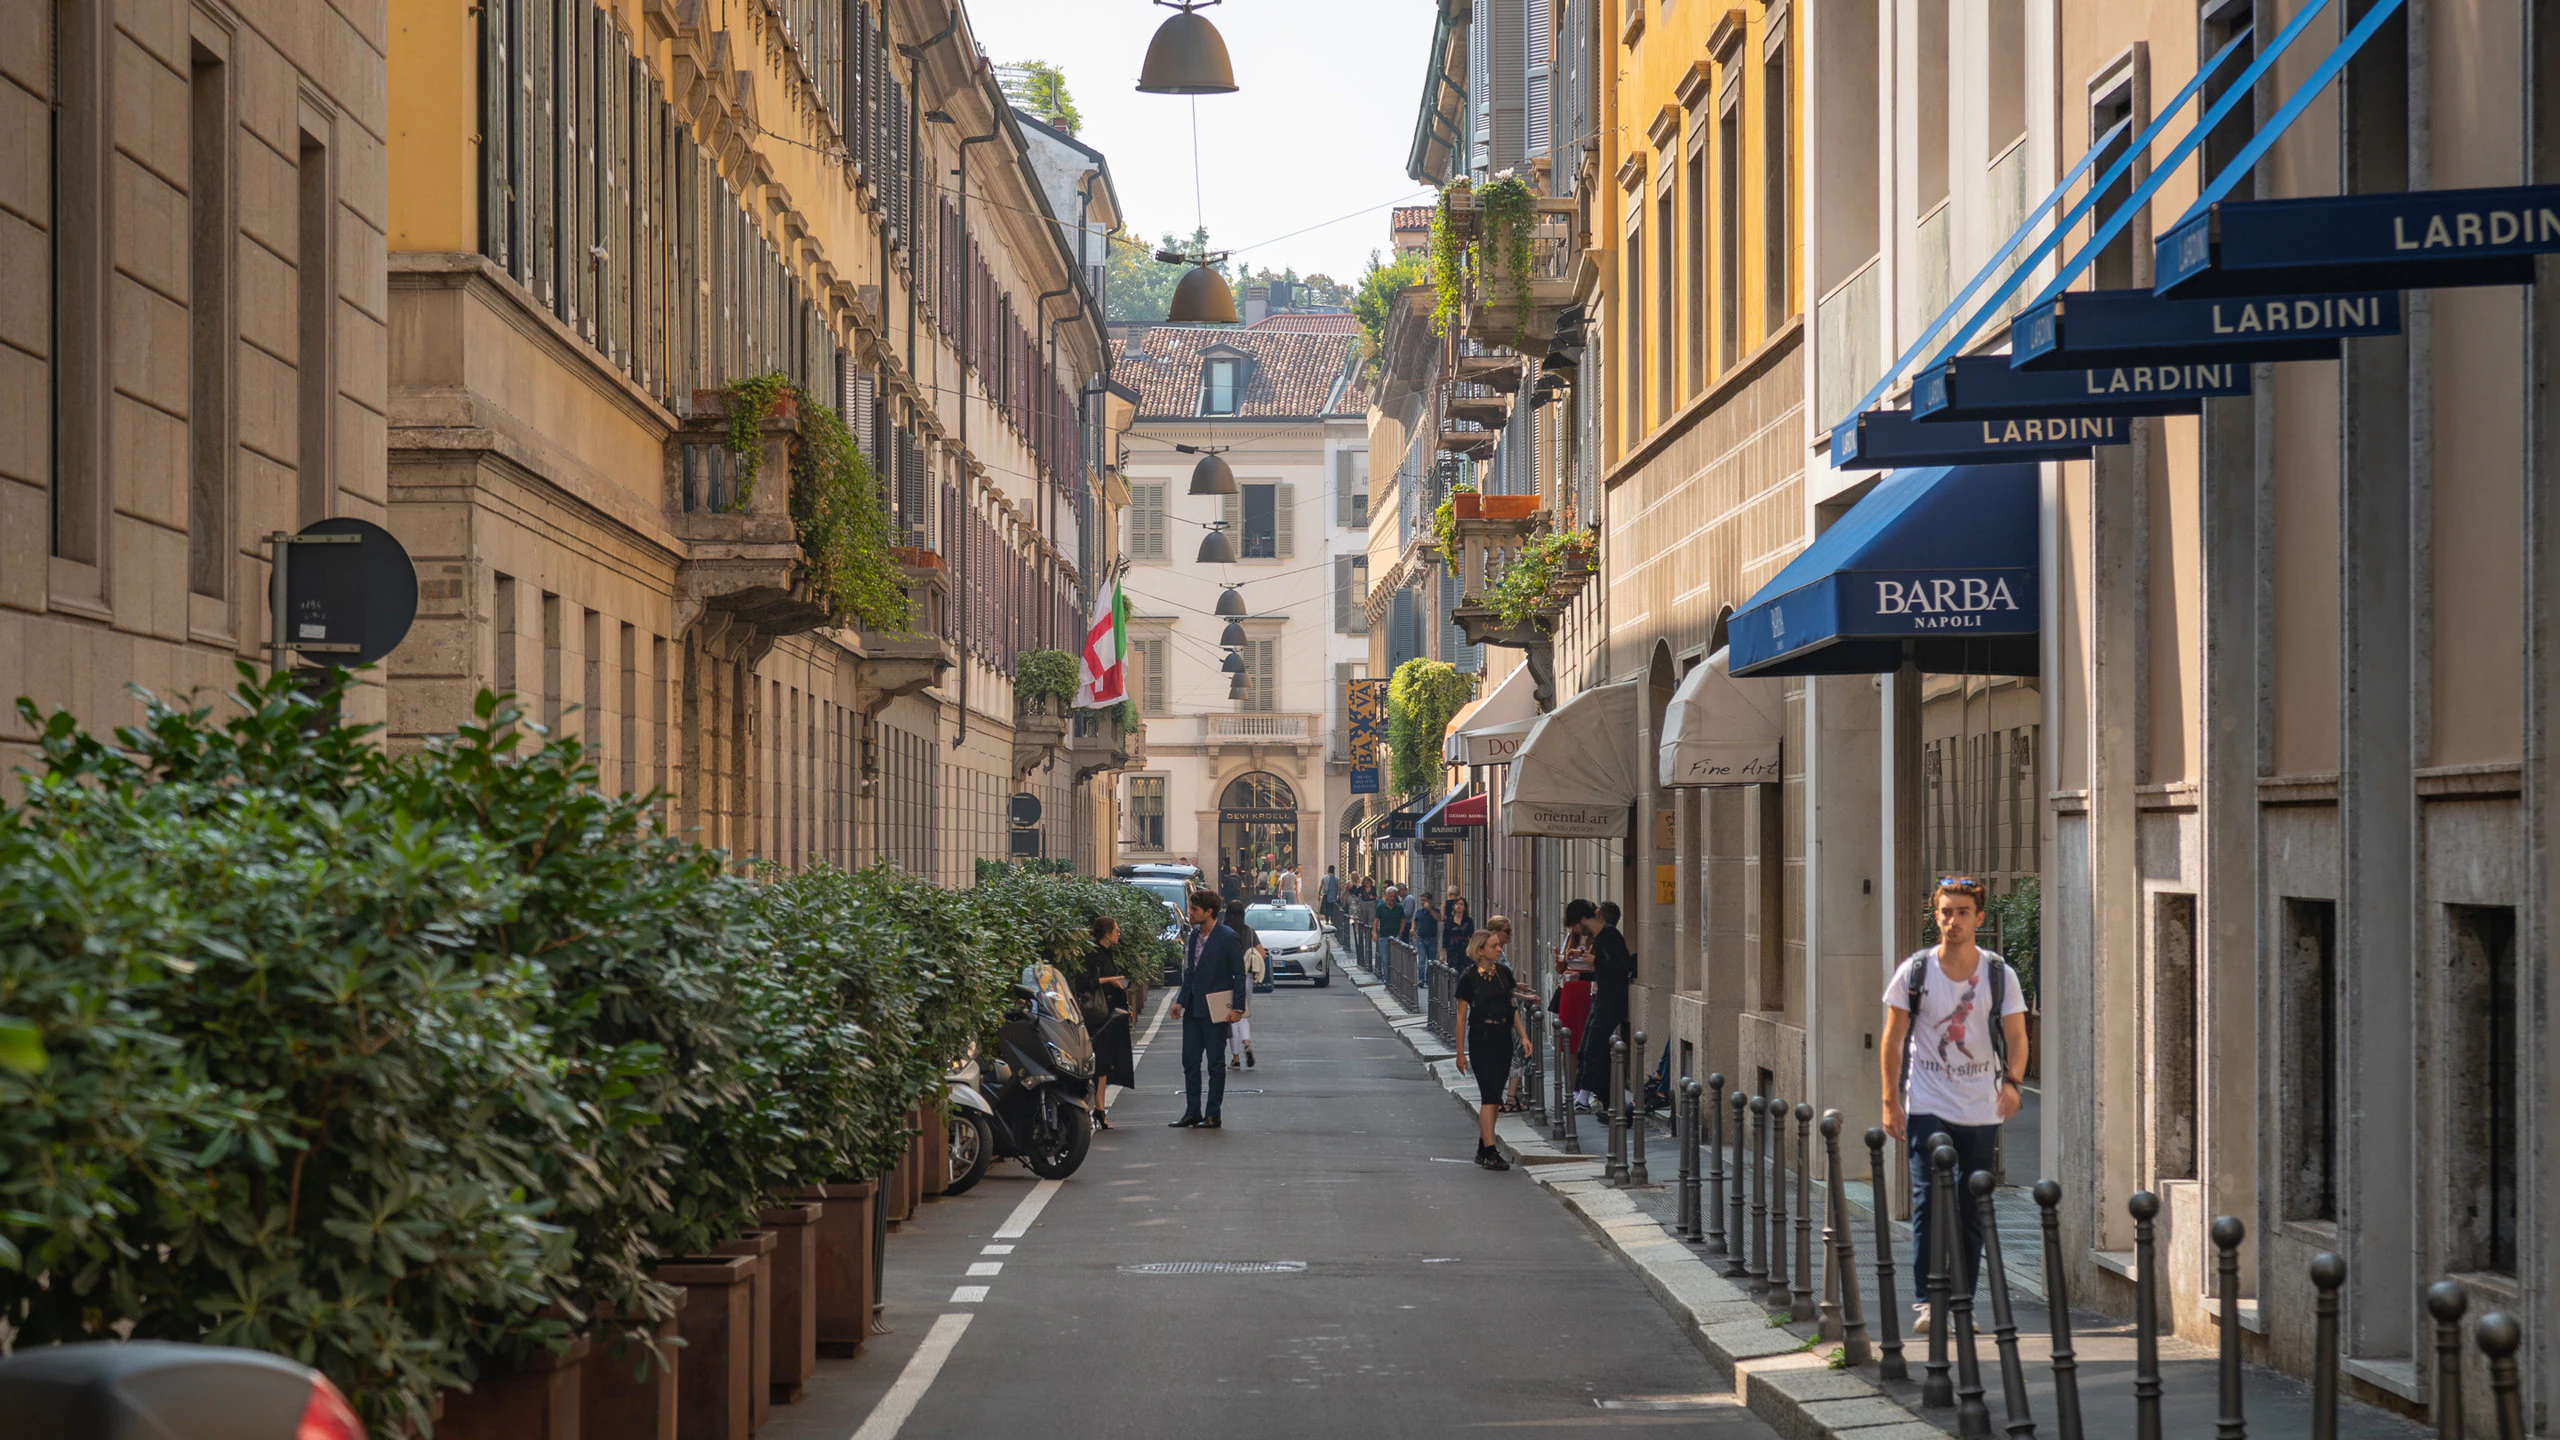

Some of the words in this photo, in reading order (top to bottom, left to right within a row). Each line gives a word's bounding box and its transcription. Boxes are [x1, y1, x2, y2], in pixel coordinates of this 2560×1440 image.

[2212, 297, 2379, 333] LARDINI
[2087, 364, 2232, 394] LARDINI
[1983, 417, 2113, 444] LARDINI
[1876, 577, 2019, 614] BARBA
[1914, 615, 1982, 628] NAPOLI
[1689, 758, 1731, 775] Fine
[1742, 758, 1778, 775] Art
[1534, 810, 1585, 822] oriental
[1590, 814, 1608, 824] art
